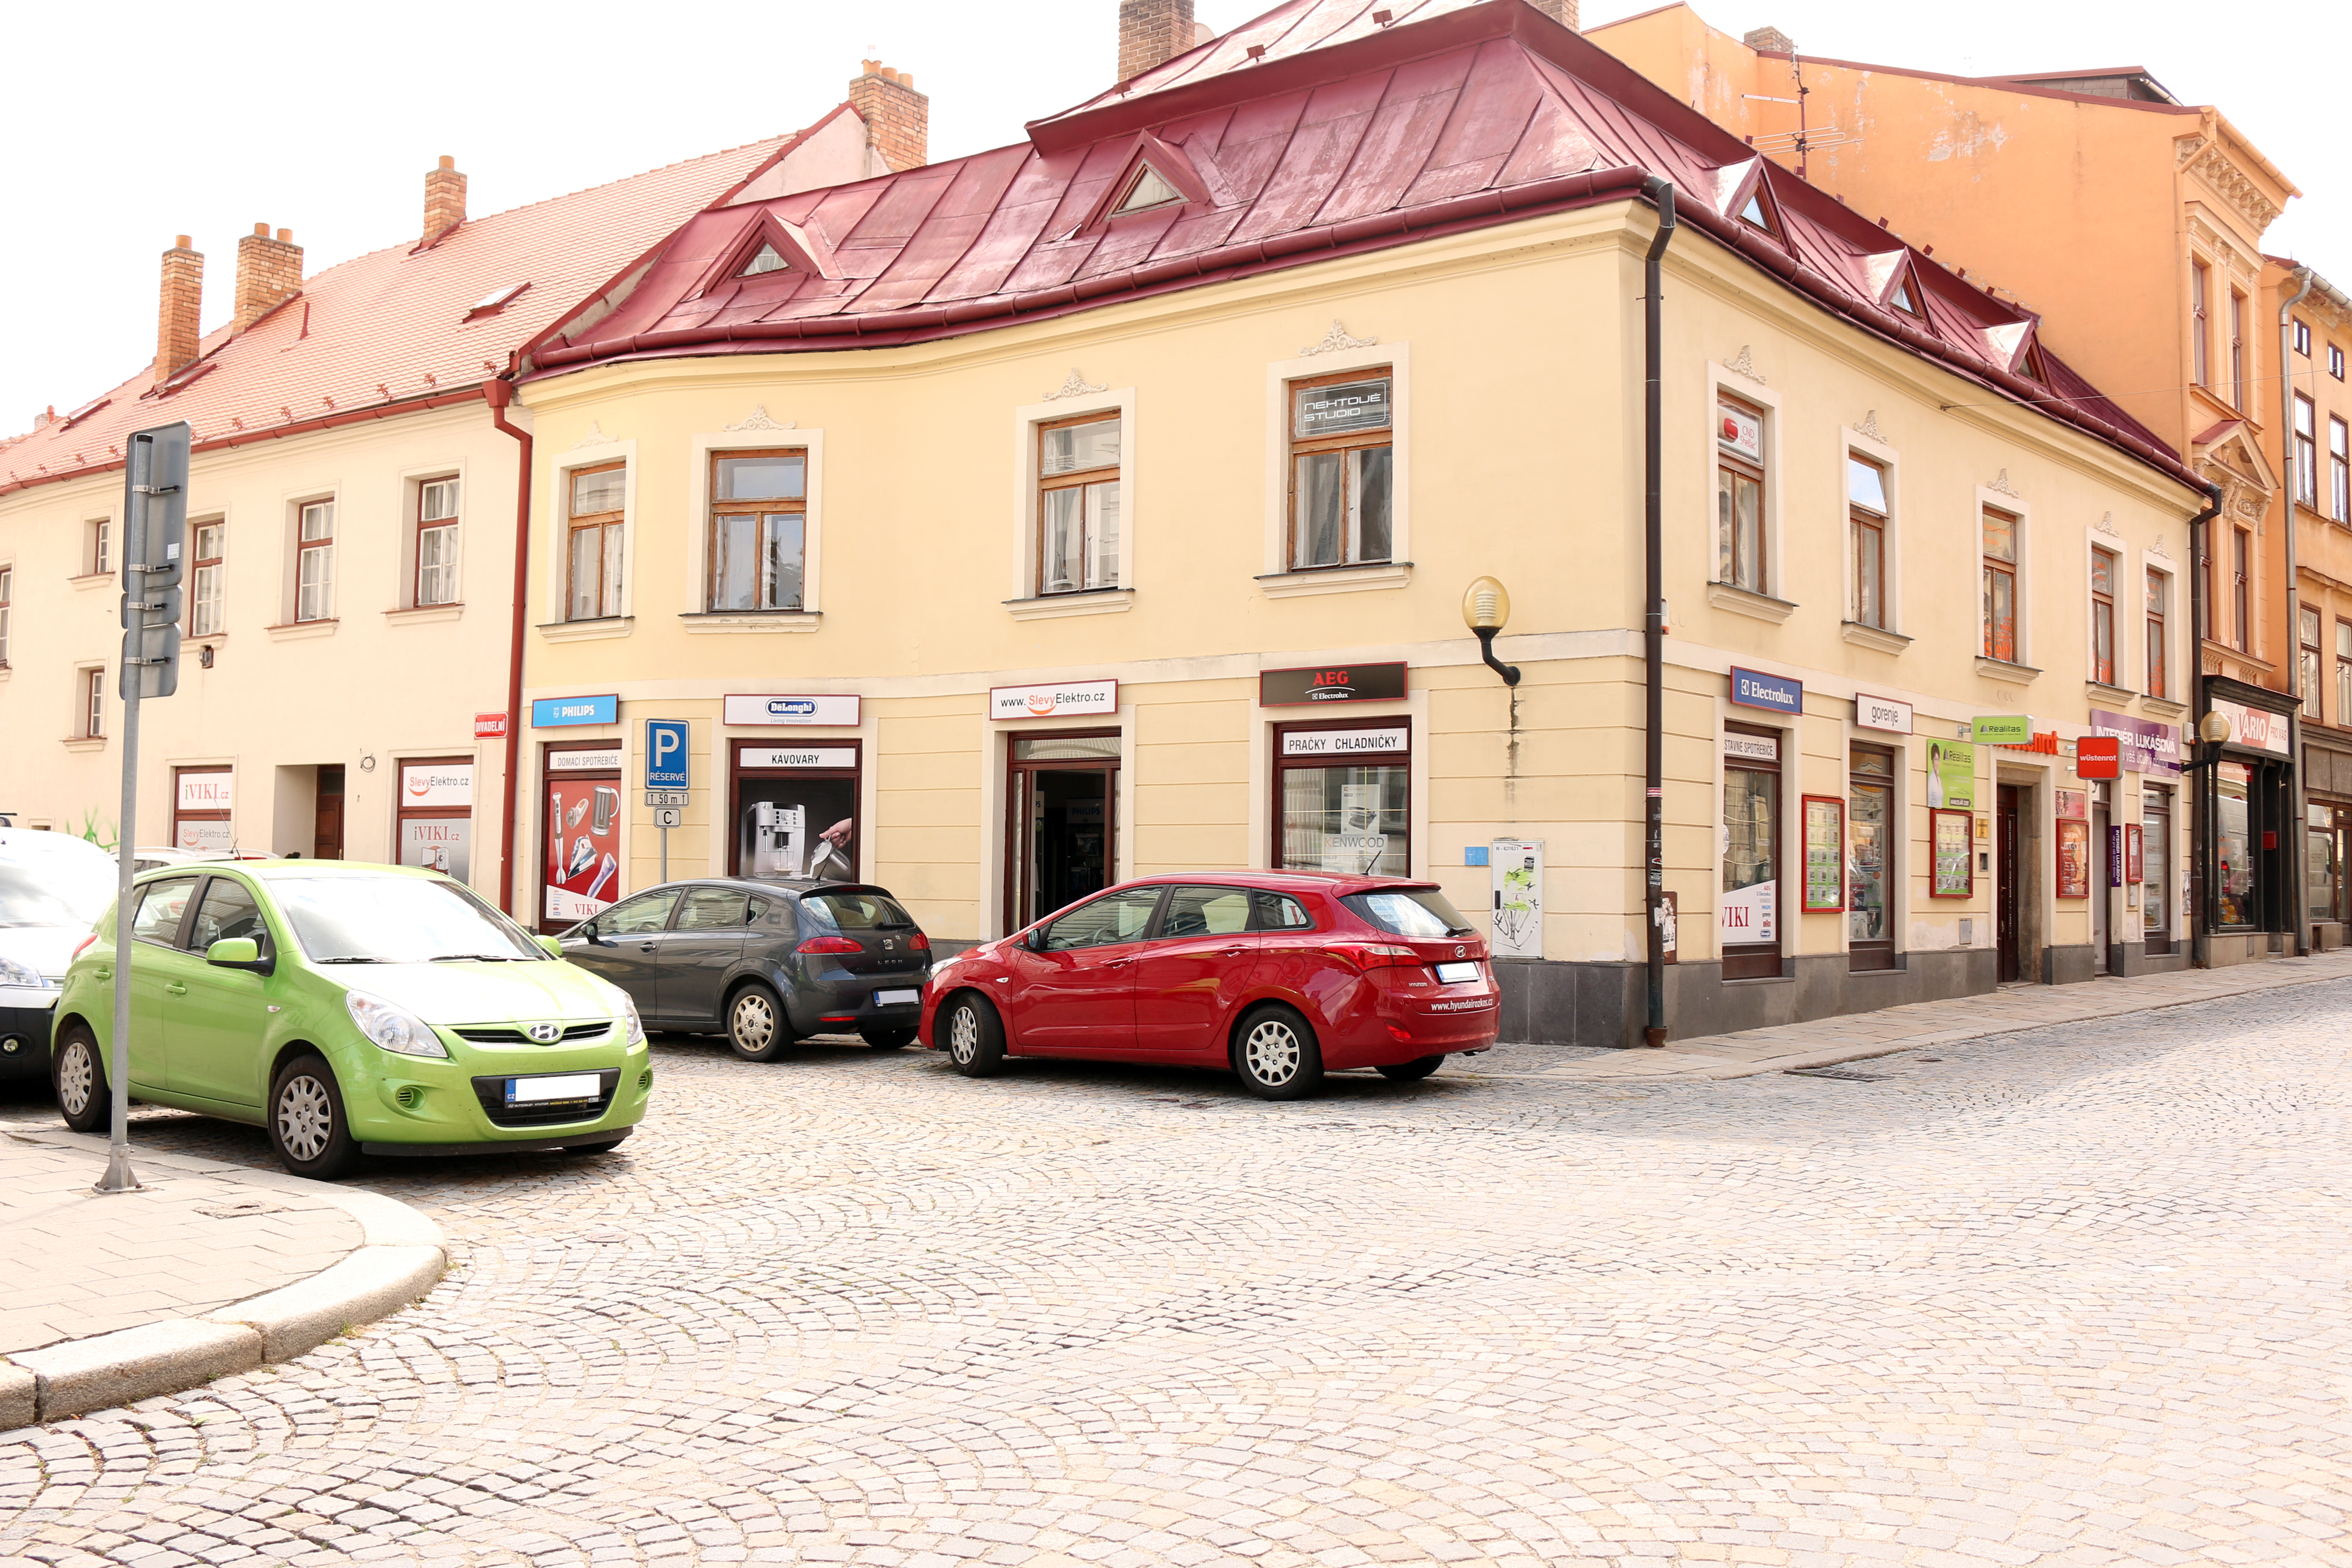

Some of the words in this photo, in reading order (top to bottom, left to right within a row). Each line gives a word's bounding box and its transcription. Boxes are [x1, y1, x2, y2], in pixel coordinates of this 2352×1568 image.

[1304, 407, 1361, 422] STUDIO
[1742, 424, 1755, 439] CND
[1312, 671, 1349, 686] AEG
[1028, 692, 1105, 707] SlevyElektro.cz
[1751, 681, 1794, 705] Electrolux
[562, 704, 595, 718] PHILIPS
[1871, 705, 1899, 726] gorenje
[476, 718, 506, 733] DIVADELNÍ
[2239, 713, 2266, 741] VARIO
[2270, 726, 2278, 739] PRO
[655, 728, 680, 767] P
[1288, 736, 1327, 751] PRAČKY
[1335, 734, 1398, 750] CHLADNIČKY
[1744, 741, 1773, 757] SPOTŘEBIČE
[2136, 733, 2176, 754] LUKÁŠOVÁ
[557, 754, 581, 767] DOMÁCÍ
[582, 754, 618, 766] SPOTŘEBIČE
[771, 752, 820, 764] KÁVOVARY
[1949, 750, 1971, 763] Realitas
[2126, 750, 2135, 763] váš
[409, 776, 469, 788] SlevyElektro.cz
[650, 771, 686, 782] RÉSERVÉ
[185, 783, 229, 800] iVIKI.cz
[659, 794, 669, 804] 50
[663, 811, 672, 825] C
[1072, 807, 1101, 815] PHILIPS
[182, 828, 230, 841] SlevyElektro.cz
[413, 825, 460, 841] iVIKI.cz
[1325, 837, 1385, 848] KENWOOD
[1431, 998, 1494, 1012] www.hyundairozkos.cz
